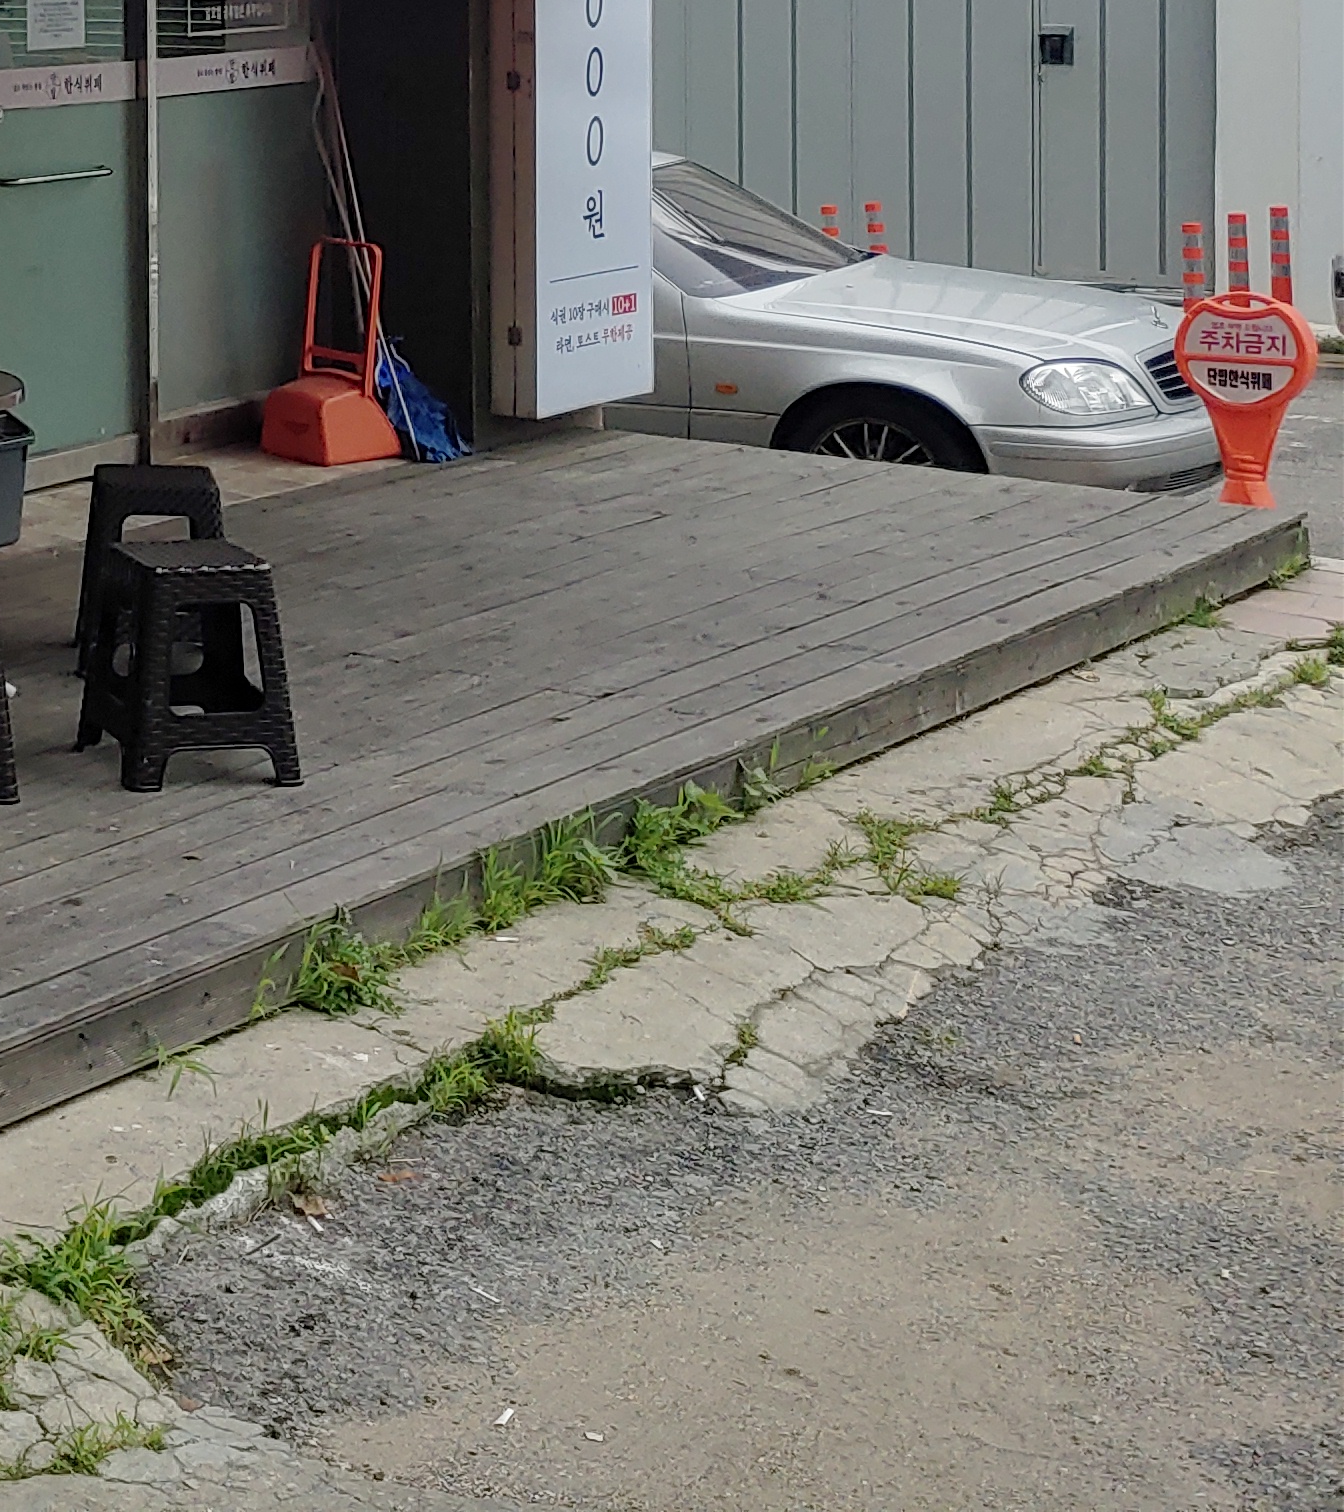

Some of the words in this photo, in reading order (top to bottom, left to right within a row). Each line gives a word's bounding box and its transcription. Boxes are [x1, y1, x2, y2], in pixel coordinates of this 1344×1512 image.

[550, 306, 567, 326] 식권
[568, 303, 586, 322] 10장
[611, 293, 637, 316] 10+1
[576, 331, 601, 349] 토스트
[1199, 329, 1288, 356] 주차금지
